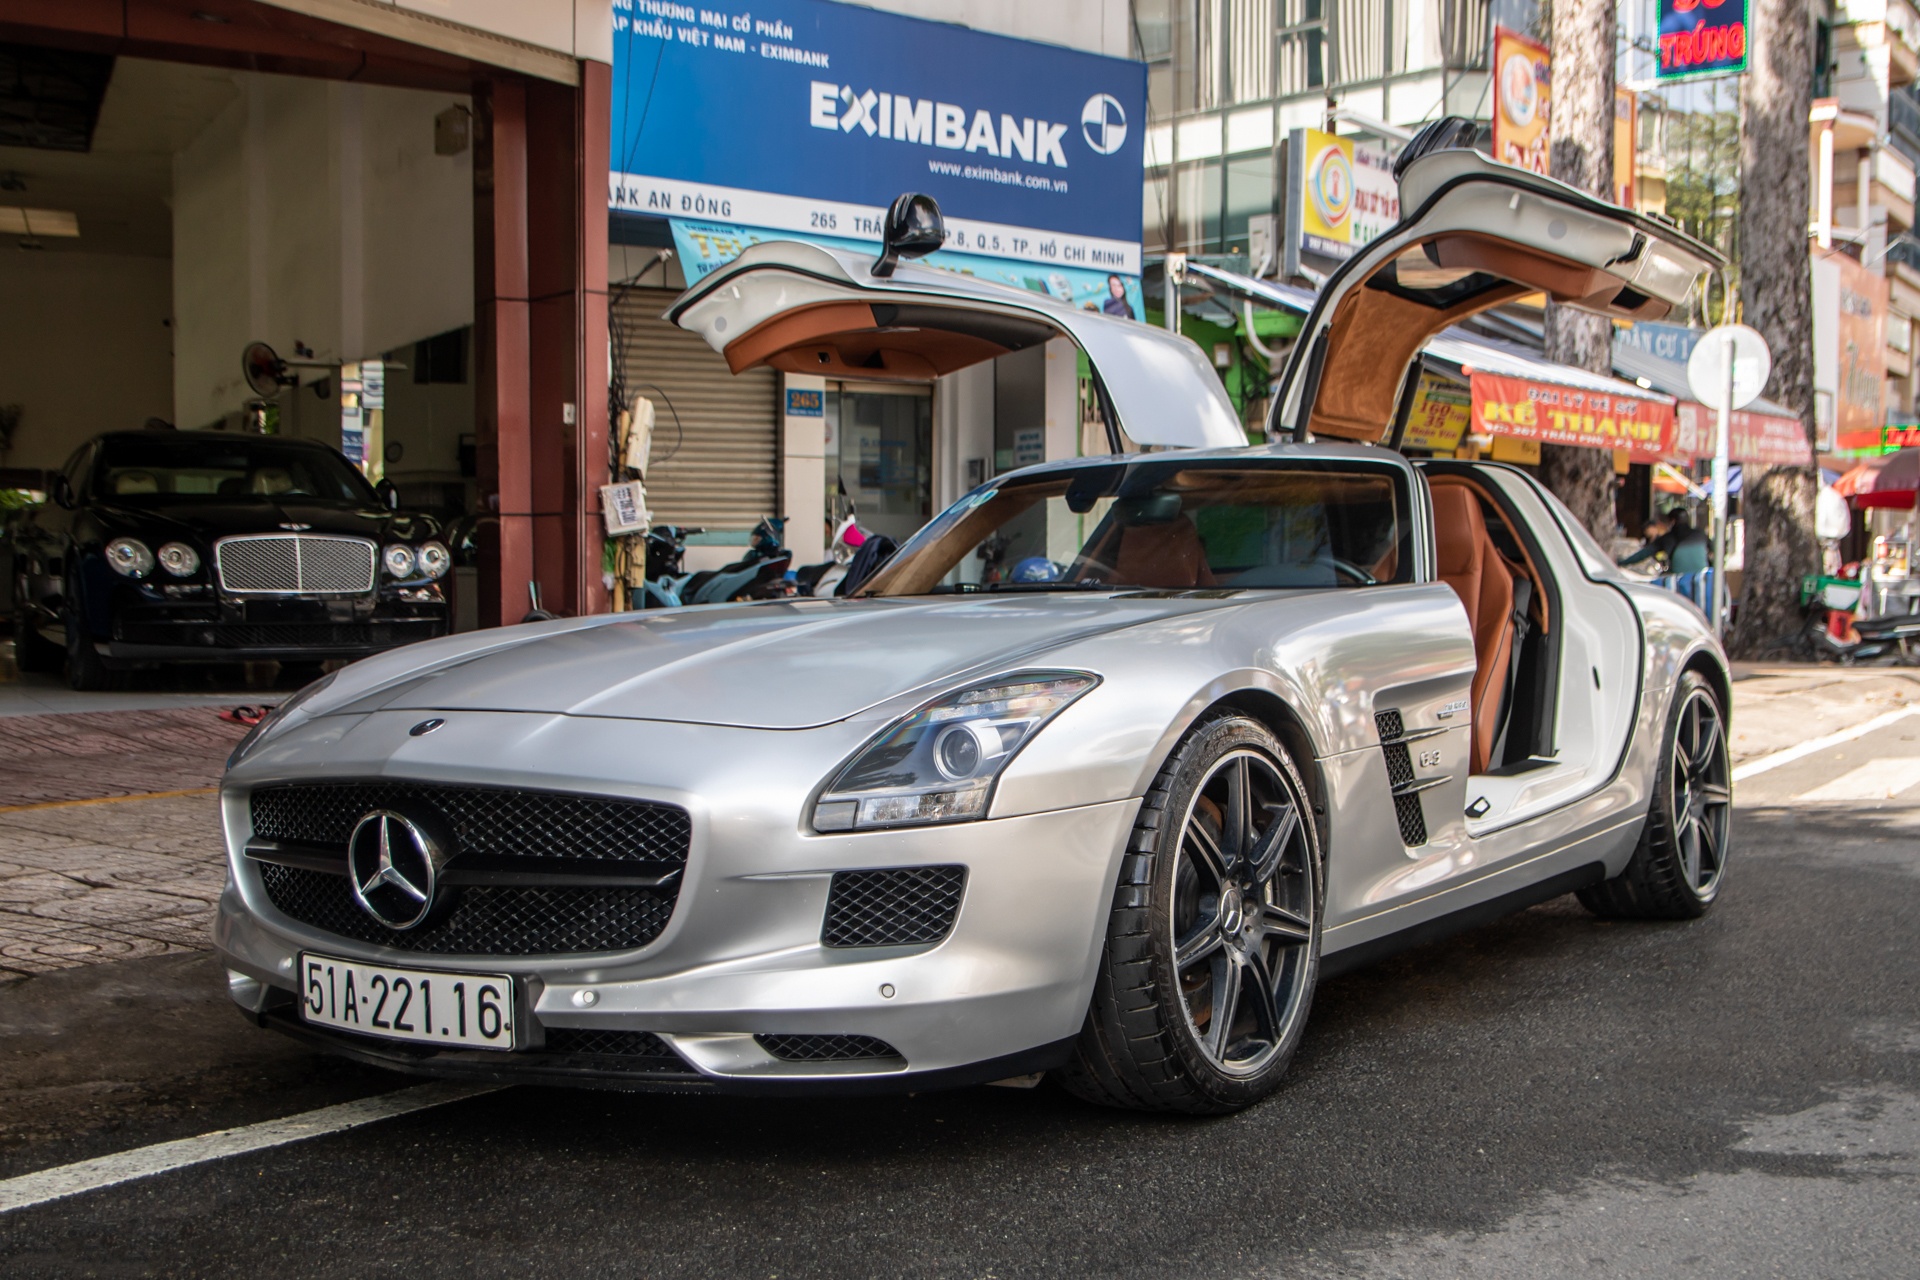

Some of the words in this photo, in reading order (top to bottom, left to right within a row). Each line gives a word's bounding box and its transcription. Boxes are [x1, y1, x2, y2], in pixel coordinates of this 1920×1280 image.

[701, 9, 727, 30] MẠI
[732, 12, 751, 33] CỔ
[756, 19, 793, 41] PHẦN
[677, 26, 709, 47] VIỆT
[714, 34, 745, 54] NAM
[761, 43, 829, 69] EXIMBANK
[810, 80, 1068, 168] EXIMBANK
[928, 160, 1068, 193] www.eximbank.com.vn
[650, 191, 671, 209] AN
[681, 193, 731, 217] ĐÔNG
[810, 213, 837, 229] 265
[977, 235, 1006, 253] Q.5,
[1012, 238, 1033, 256] TP.
[1064, 243, 1086, 262] CHÍ
[1092, 250, 1124, 267] MINH
[791, 392, 819, 408] 265
[1547, 409, 1661, 442] THANH
[1420, 750, 1441, 767] 6.3
